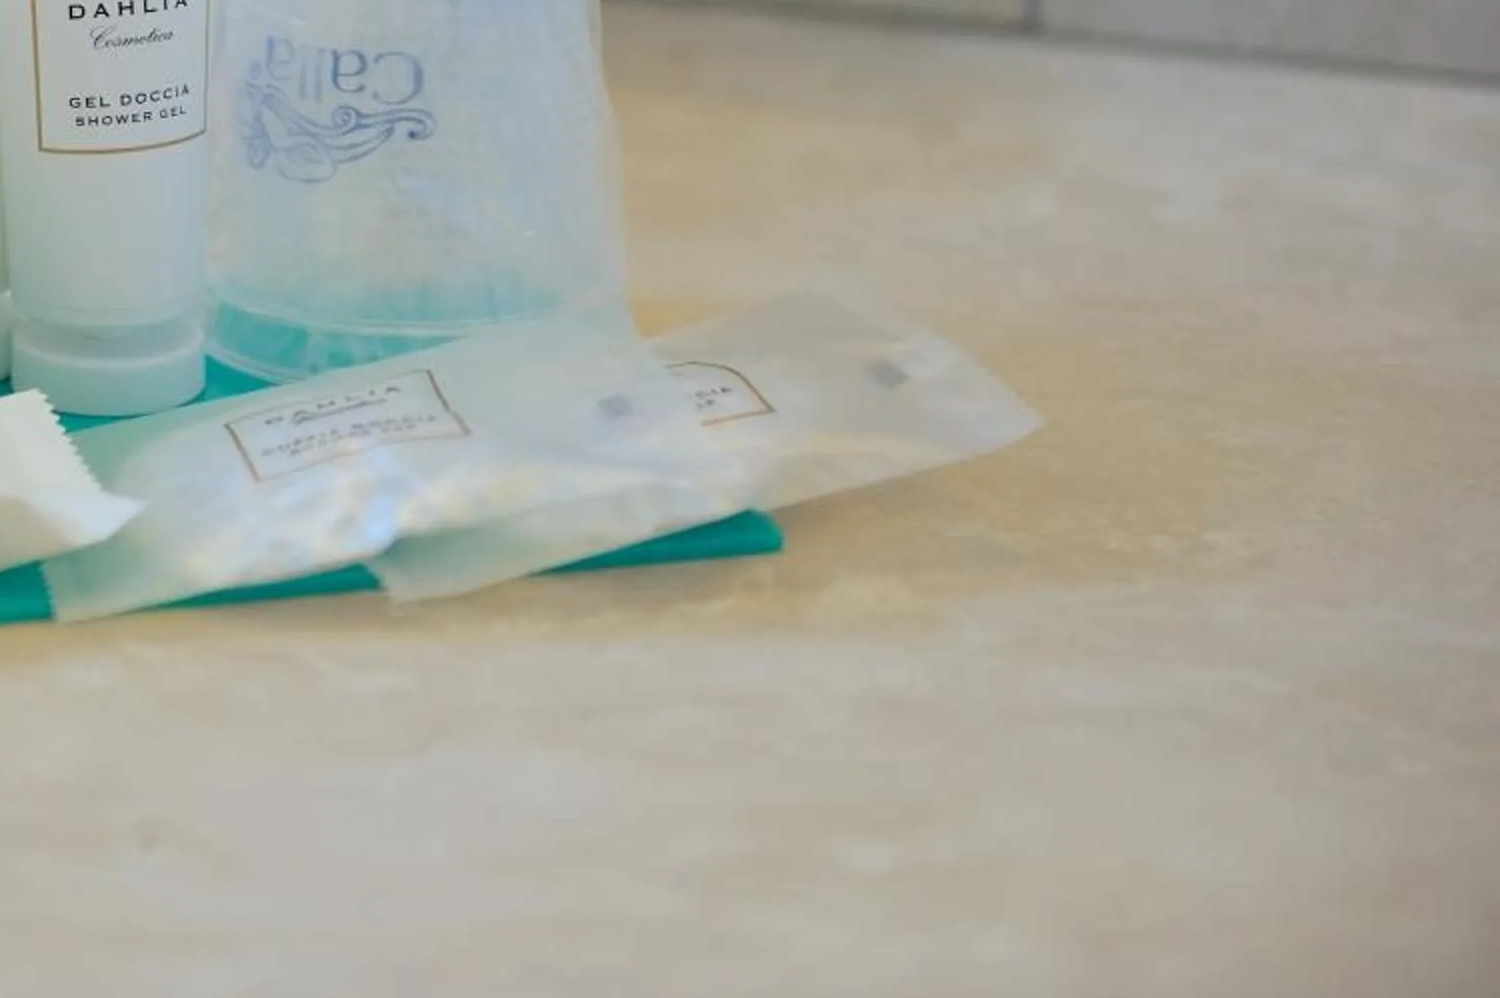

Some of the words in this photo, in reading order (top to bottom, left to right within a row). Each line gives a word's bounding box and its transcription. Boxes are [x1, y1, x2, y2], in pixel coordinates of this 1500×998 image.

[68, 95, 112, 110] GEL
[119, 83, 191, 108] DOCCIA
[75, 111, 153, 129] SHOWER
[160, 104, 187, 120] GEL
